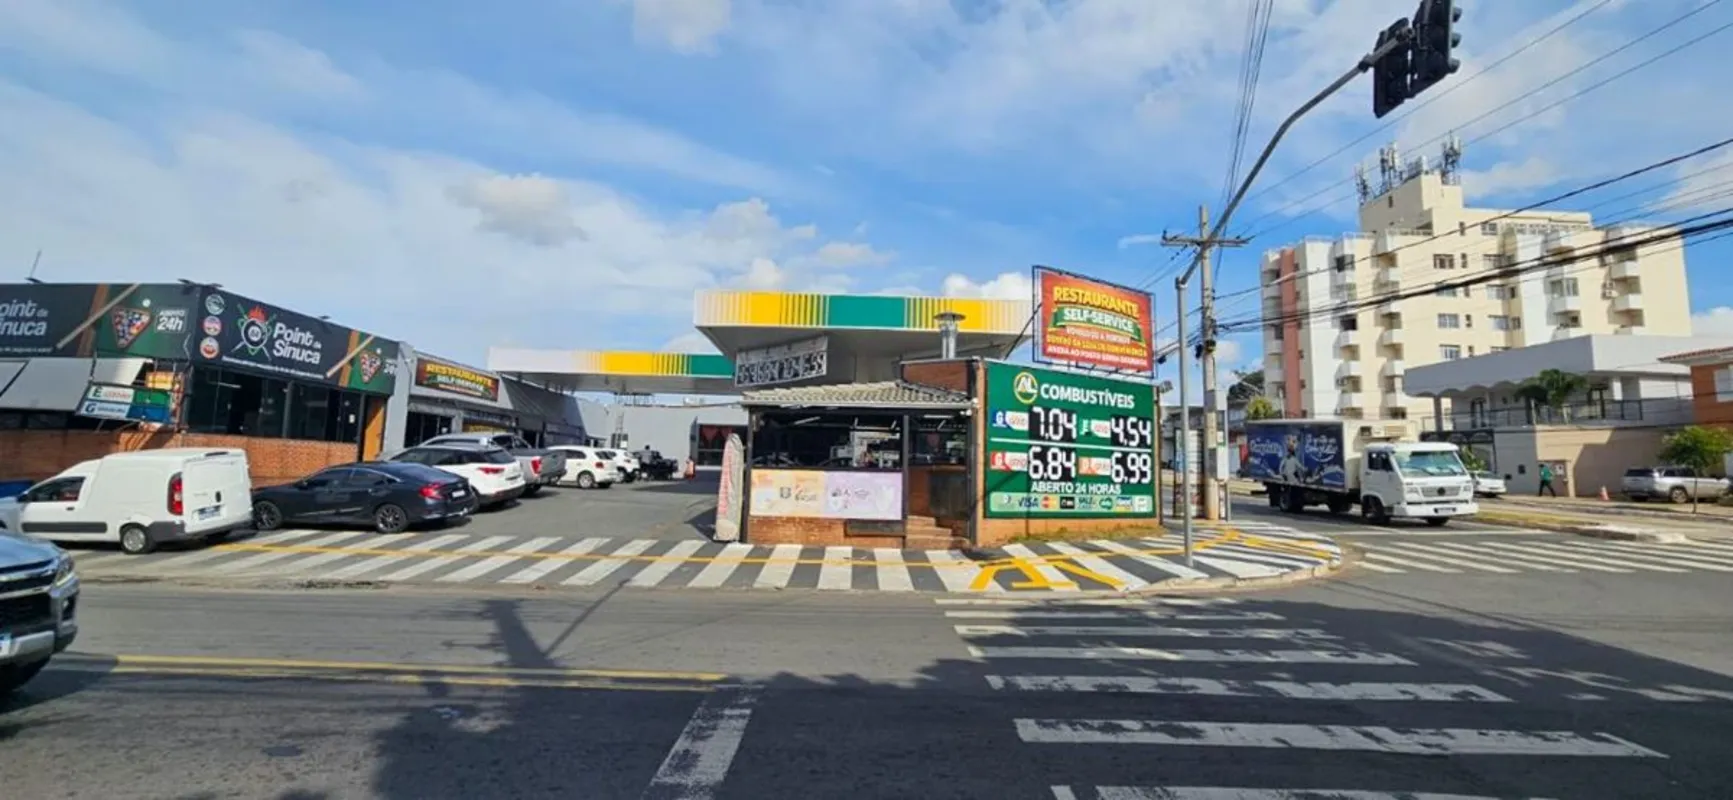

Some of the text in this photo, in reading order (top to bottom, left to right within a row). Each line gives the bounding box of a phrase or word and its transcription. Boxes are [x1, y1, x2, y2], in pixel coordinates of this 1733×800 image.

[0, 299, 36, 317] oint
[1053, 286, 1140, 319] RESTAURANTE
[0, 316, 47, 336] inuca
[157, 317, 184, 330] 24h
[1063, 307, 1135, 333] SELF-SERVICE
[273, 321, 313, 346] Point
[272, 339, 321, 365] Sinuca
[1040, 383, 1136, 409] COMBUSTÍVEIS
[1032, 406, 1077, 440] 7,04
[1111, 416, 1150, 447] 4,54
[1029, 446, 1076, 480] 6,84
[1110, 452, 1151, 484] 6,99
[1031, 481, 1122, 497] ABERTO 24 HORAS
[1018, 497, 1038, 508] VISA
